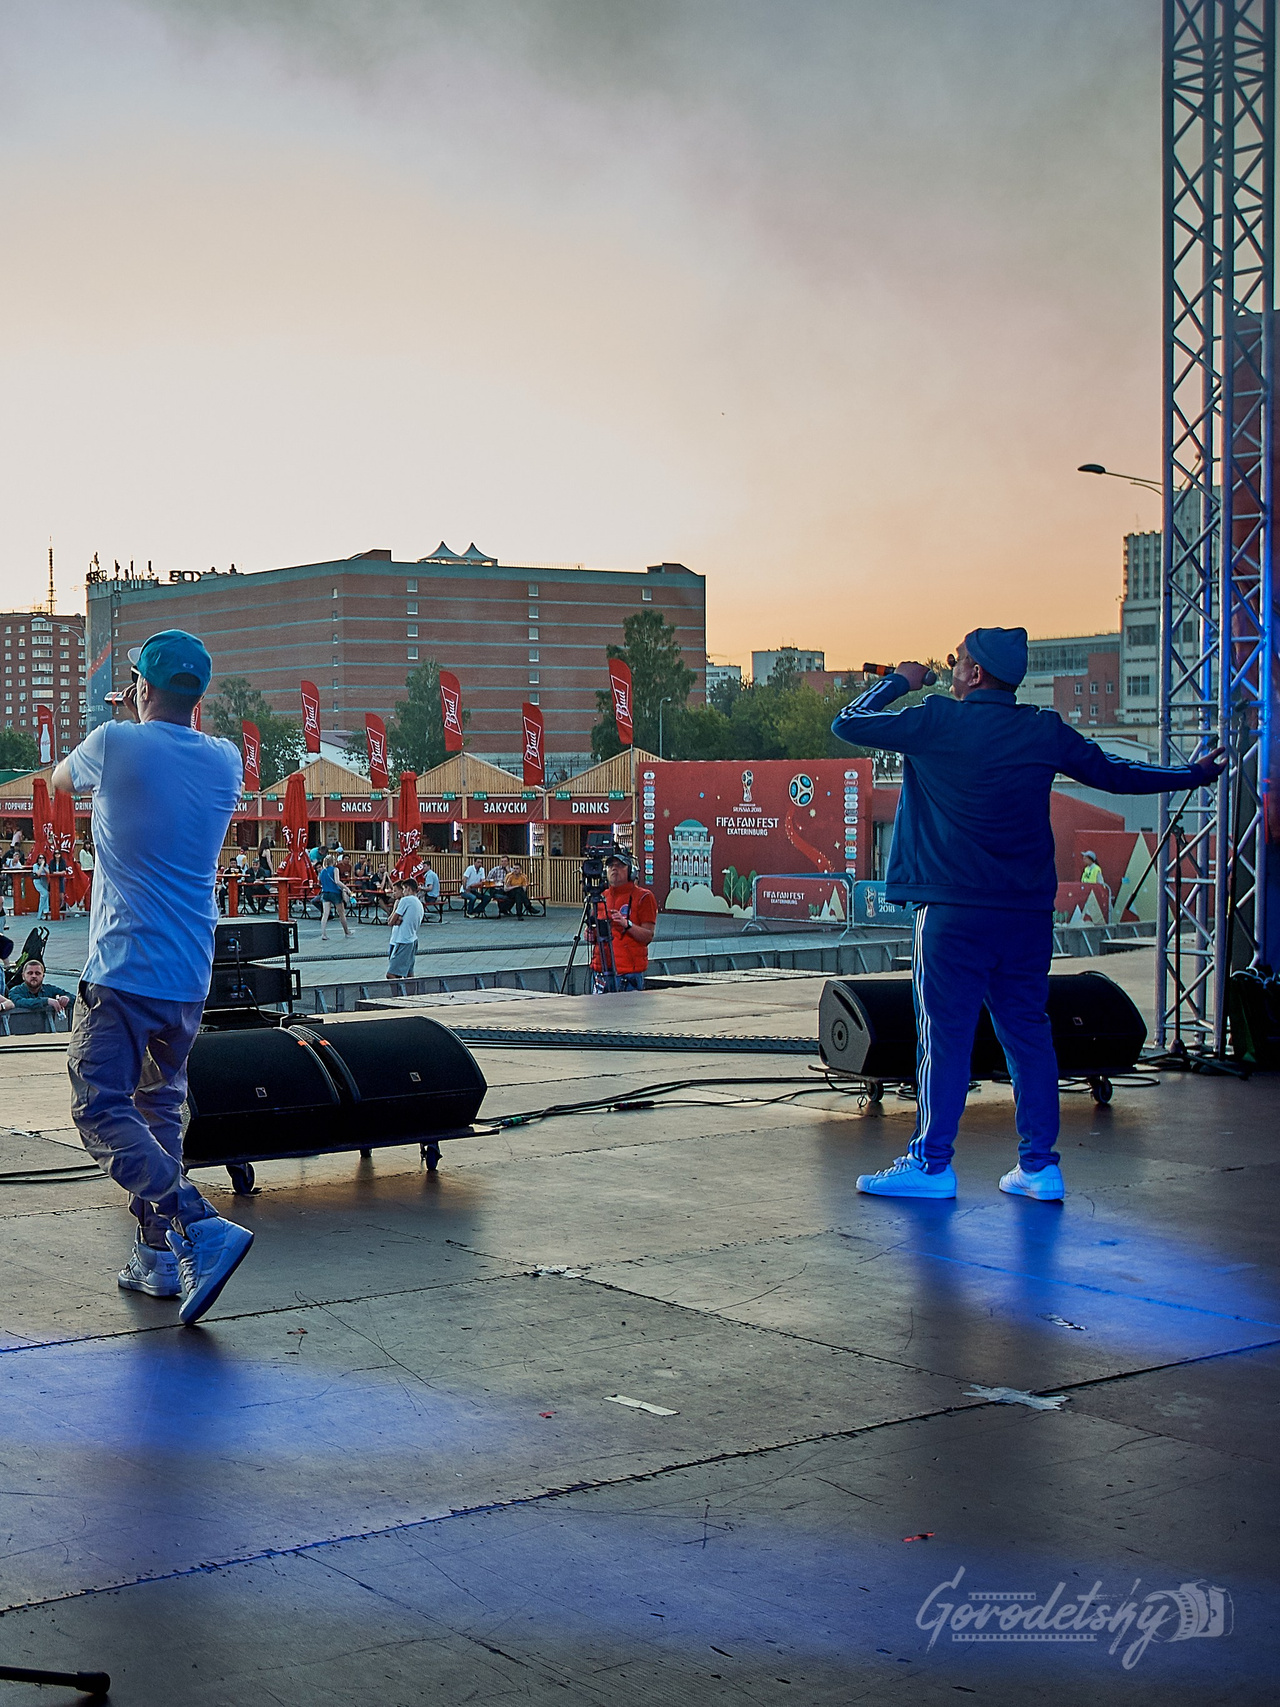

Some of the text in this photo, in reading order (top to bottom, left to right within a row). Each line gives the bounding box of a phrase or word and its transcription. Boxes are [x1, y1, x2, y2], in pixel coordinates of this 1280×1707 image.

[444, 699, 456, 726] Bud
[615, 689, 627, 720] Bud
[305, 704, 316, 730] Bud
[371, 739, 382, 766] Bud
[525, 730, 537, 759] Bud
[245, 744, 255, 770] Bud
[341, 802, 372, 812] SNACKS
[419, 802, 449, 812] ПИТКИ
[483, 802, 527, 813] ЗАКУСКИ
[572, 802, 610, 813] DRINKS
[716, 817, 779, 828] FIFA FAN FEST
[727, 828, 768, 836] EKATERINBURG
